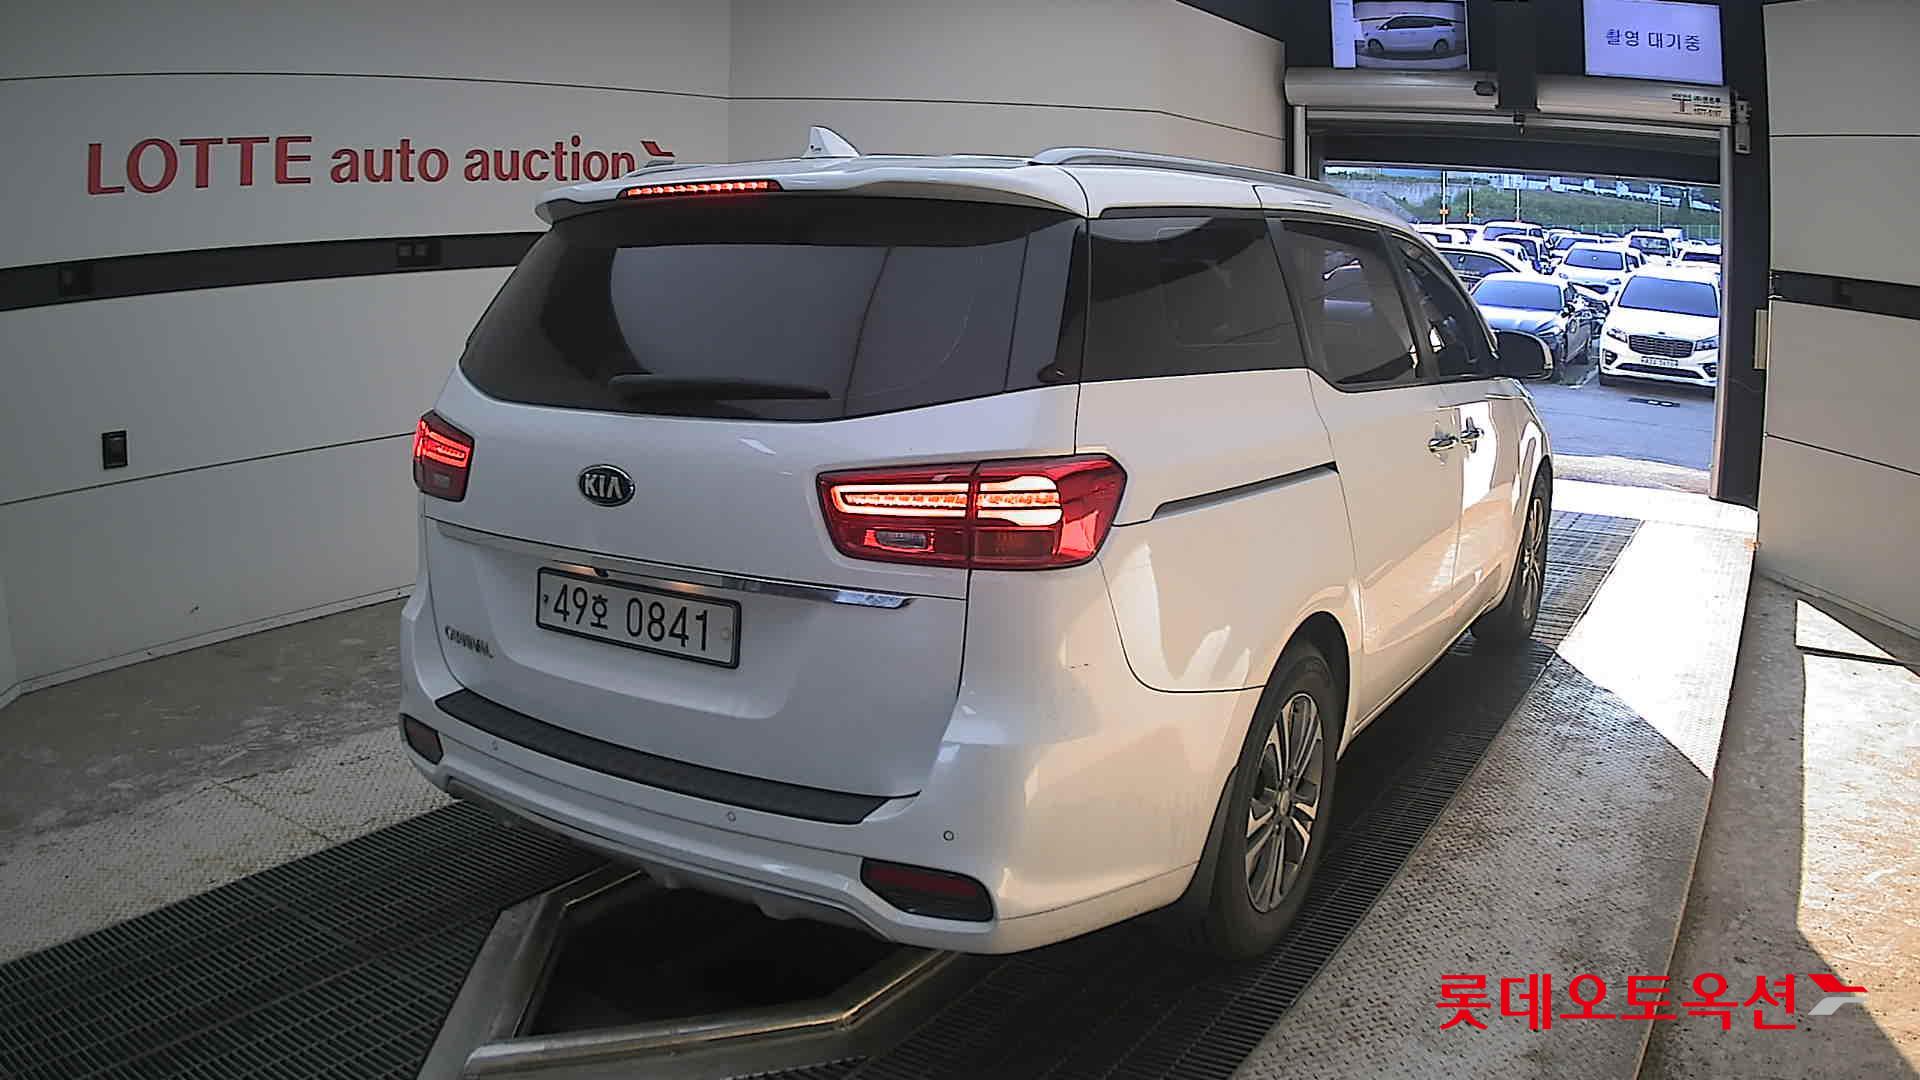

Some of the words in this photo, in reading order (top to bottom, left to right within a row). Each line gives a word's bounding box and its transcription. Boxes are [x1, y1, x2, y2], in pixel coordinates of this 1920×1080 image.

[1647, 31, 1701, 52] 대기중
[87, 135, 312, 195] LOTTE
[330, 138, 449, 183] auto
[464, 135, 635, 182] auction
[584, 473, 623, 498] KIA
[553, 583, 608, 630] 49호
[626, 597, 709, 651] 0841
